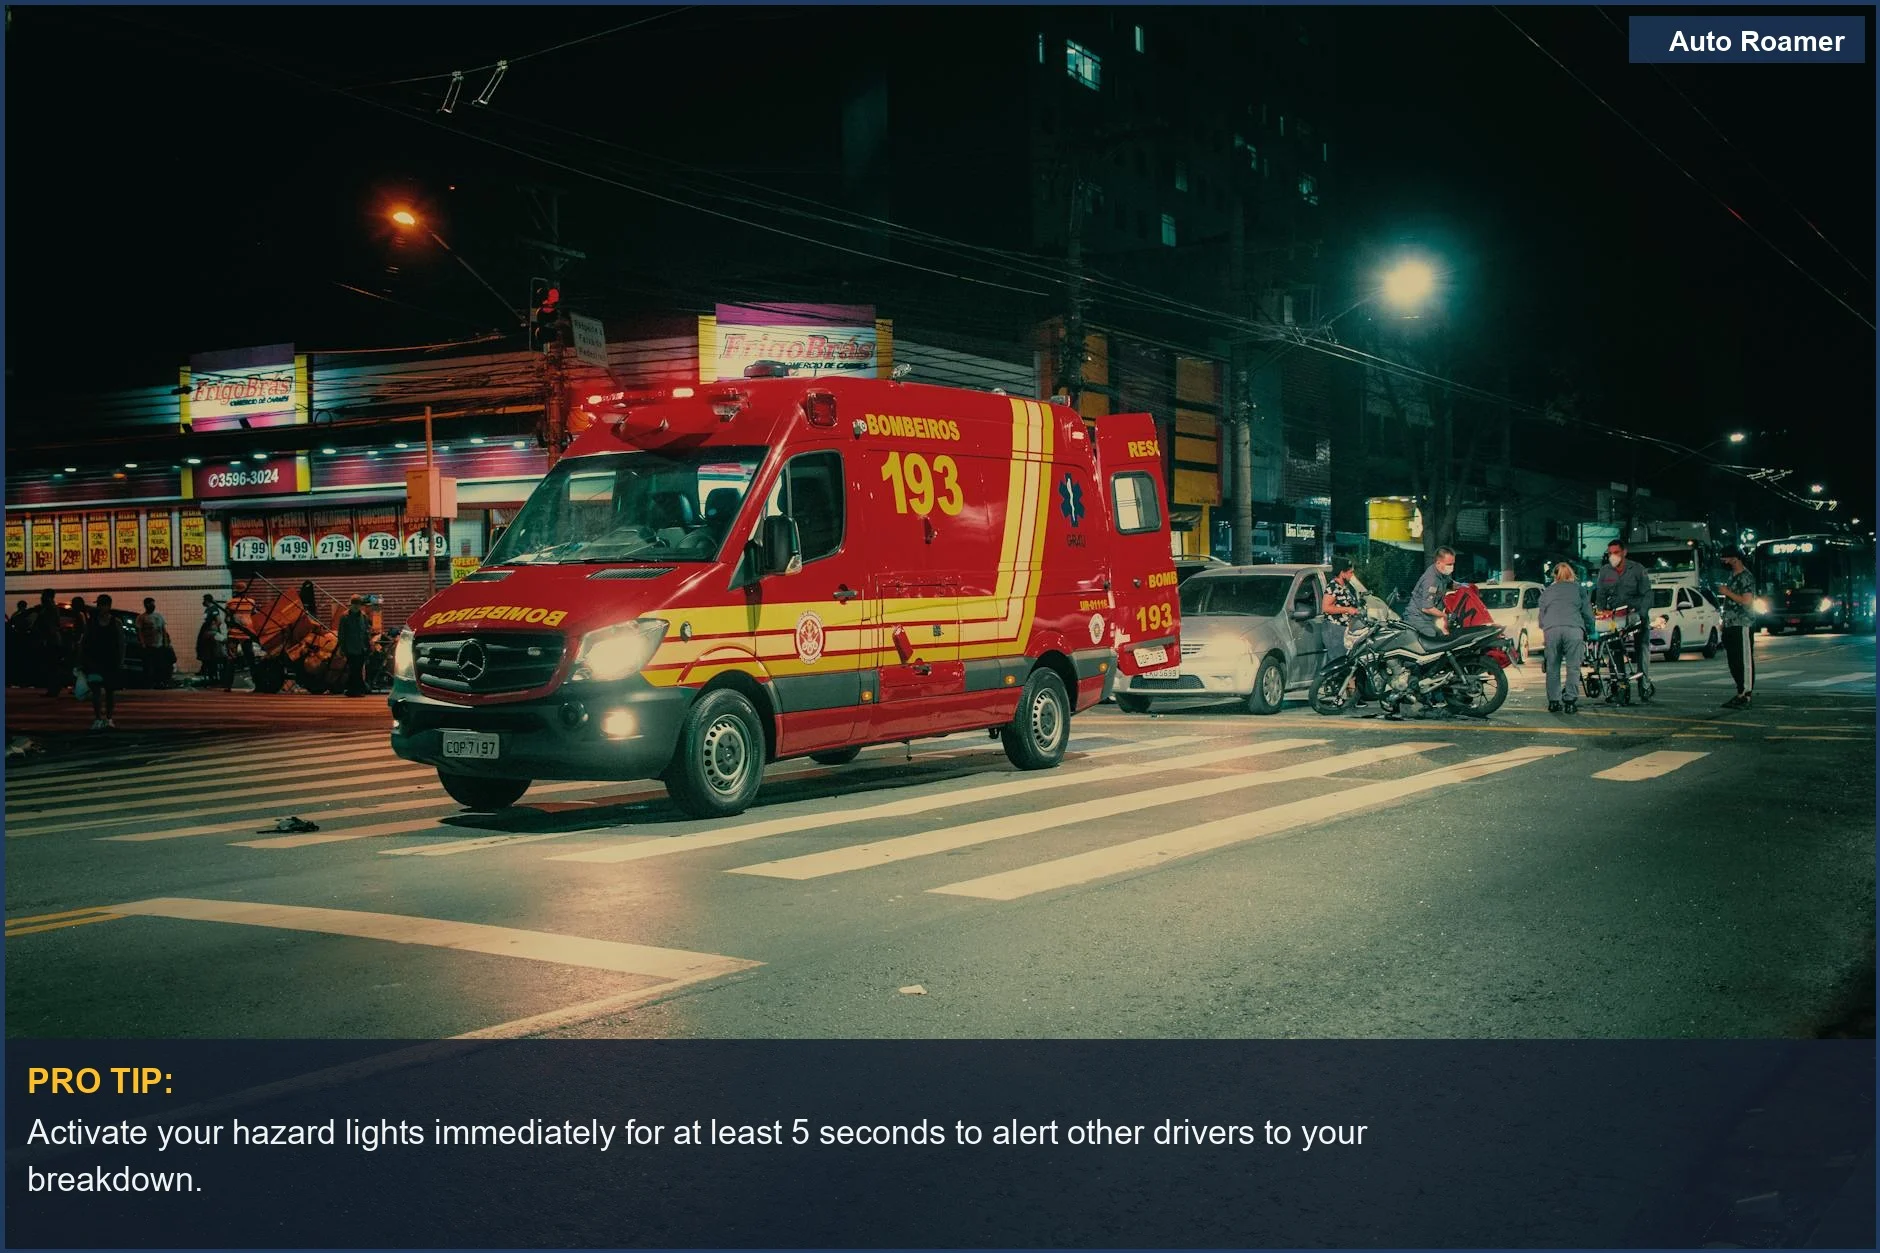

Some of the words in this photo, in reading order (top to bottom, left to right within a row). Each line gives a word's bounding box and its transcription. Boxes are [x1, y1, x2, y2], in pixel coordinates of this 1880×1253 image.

[193, 374, 293, 406] FrigoBrás
[865, 413, 960, 441] BOMBEIROS
[218, 468, 280, 487] 3596-3024
[880, 450, 964, 516] 193
[1136, 603, 1173, 632] 193
